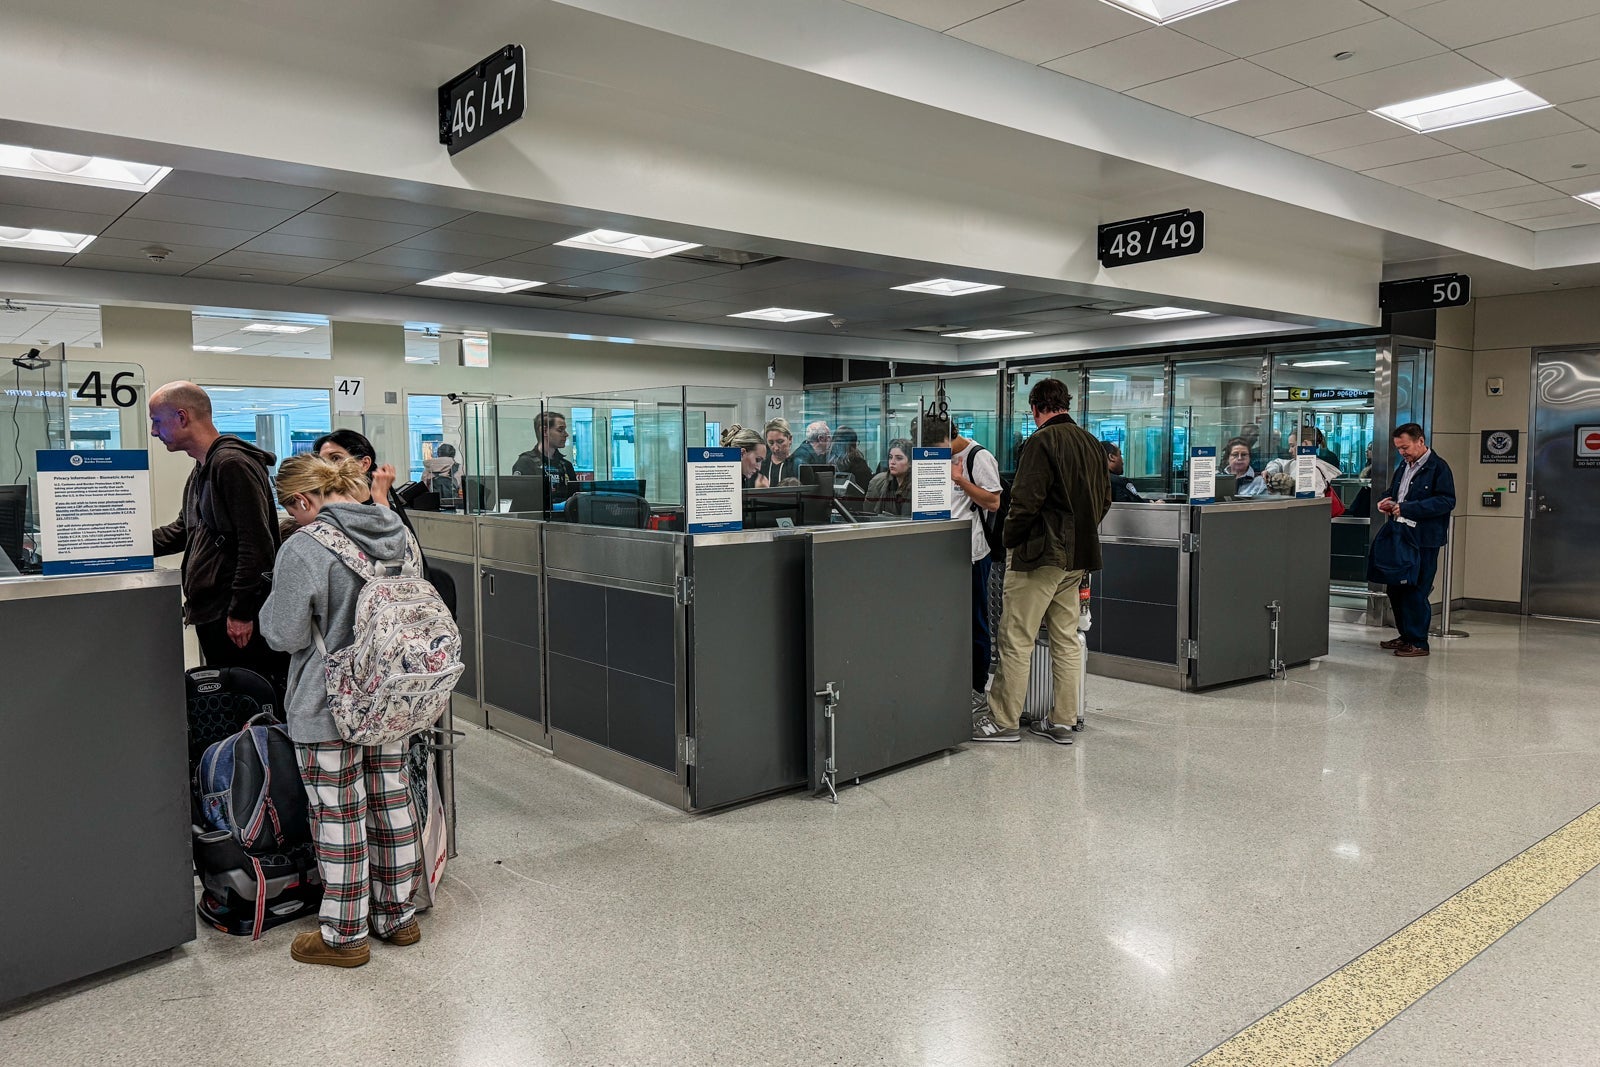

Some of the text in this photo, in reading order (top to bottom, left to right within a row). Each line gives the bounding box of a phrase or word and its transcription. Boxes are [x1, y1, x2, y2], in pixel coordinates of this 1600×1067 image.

[1432, 281, 1462, 303] 50
[76, 371, 138, 408] 46
[338, 380, 360, 396] 47
[768, 397, 782, 410] 49
[926, 402, 949, 422] 48
[1304, 413, 1316, 428] 50
